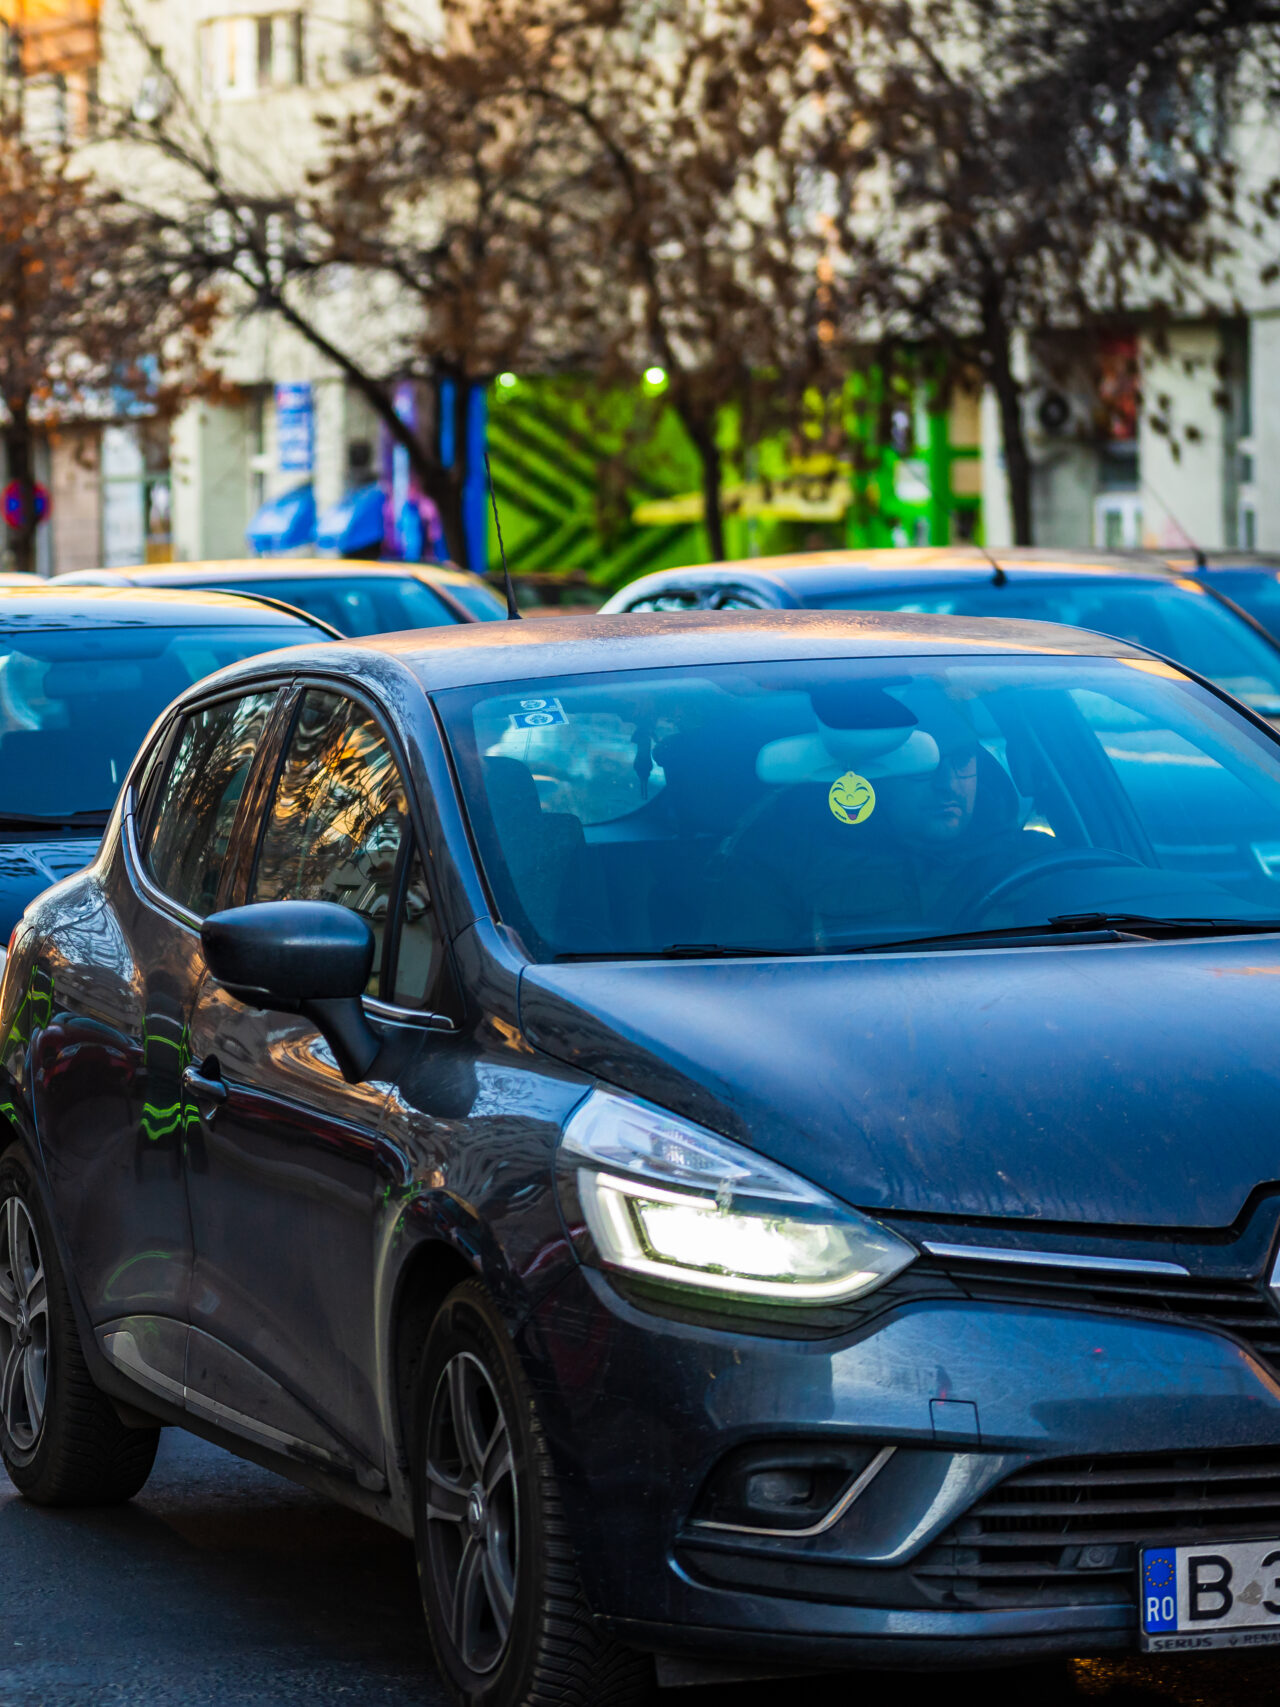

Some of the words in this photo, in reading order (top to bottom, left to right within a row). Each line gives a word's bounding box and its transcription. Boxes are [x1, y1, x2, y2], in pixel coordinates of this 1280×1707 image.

[1187, 1554, 1233, 1621] B
[1146, 1596, 1174, 1622] RO
[1243, 1633, 1280, 1645] RENA
